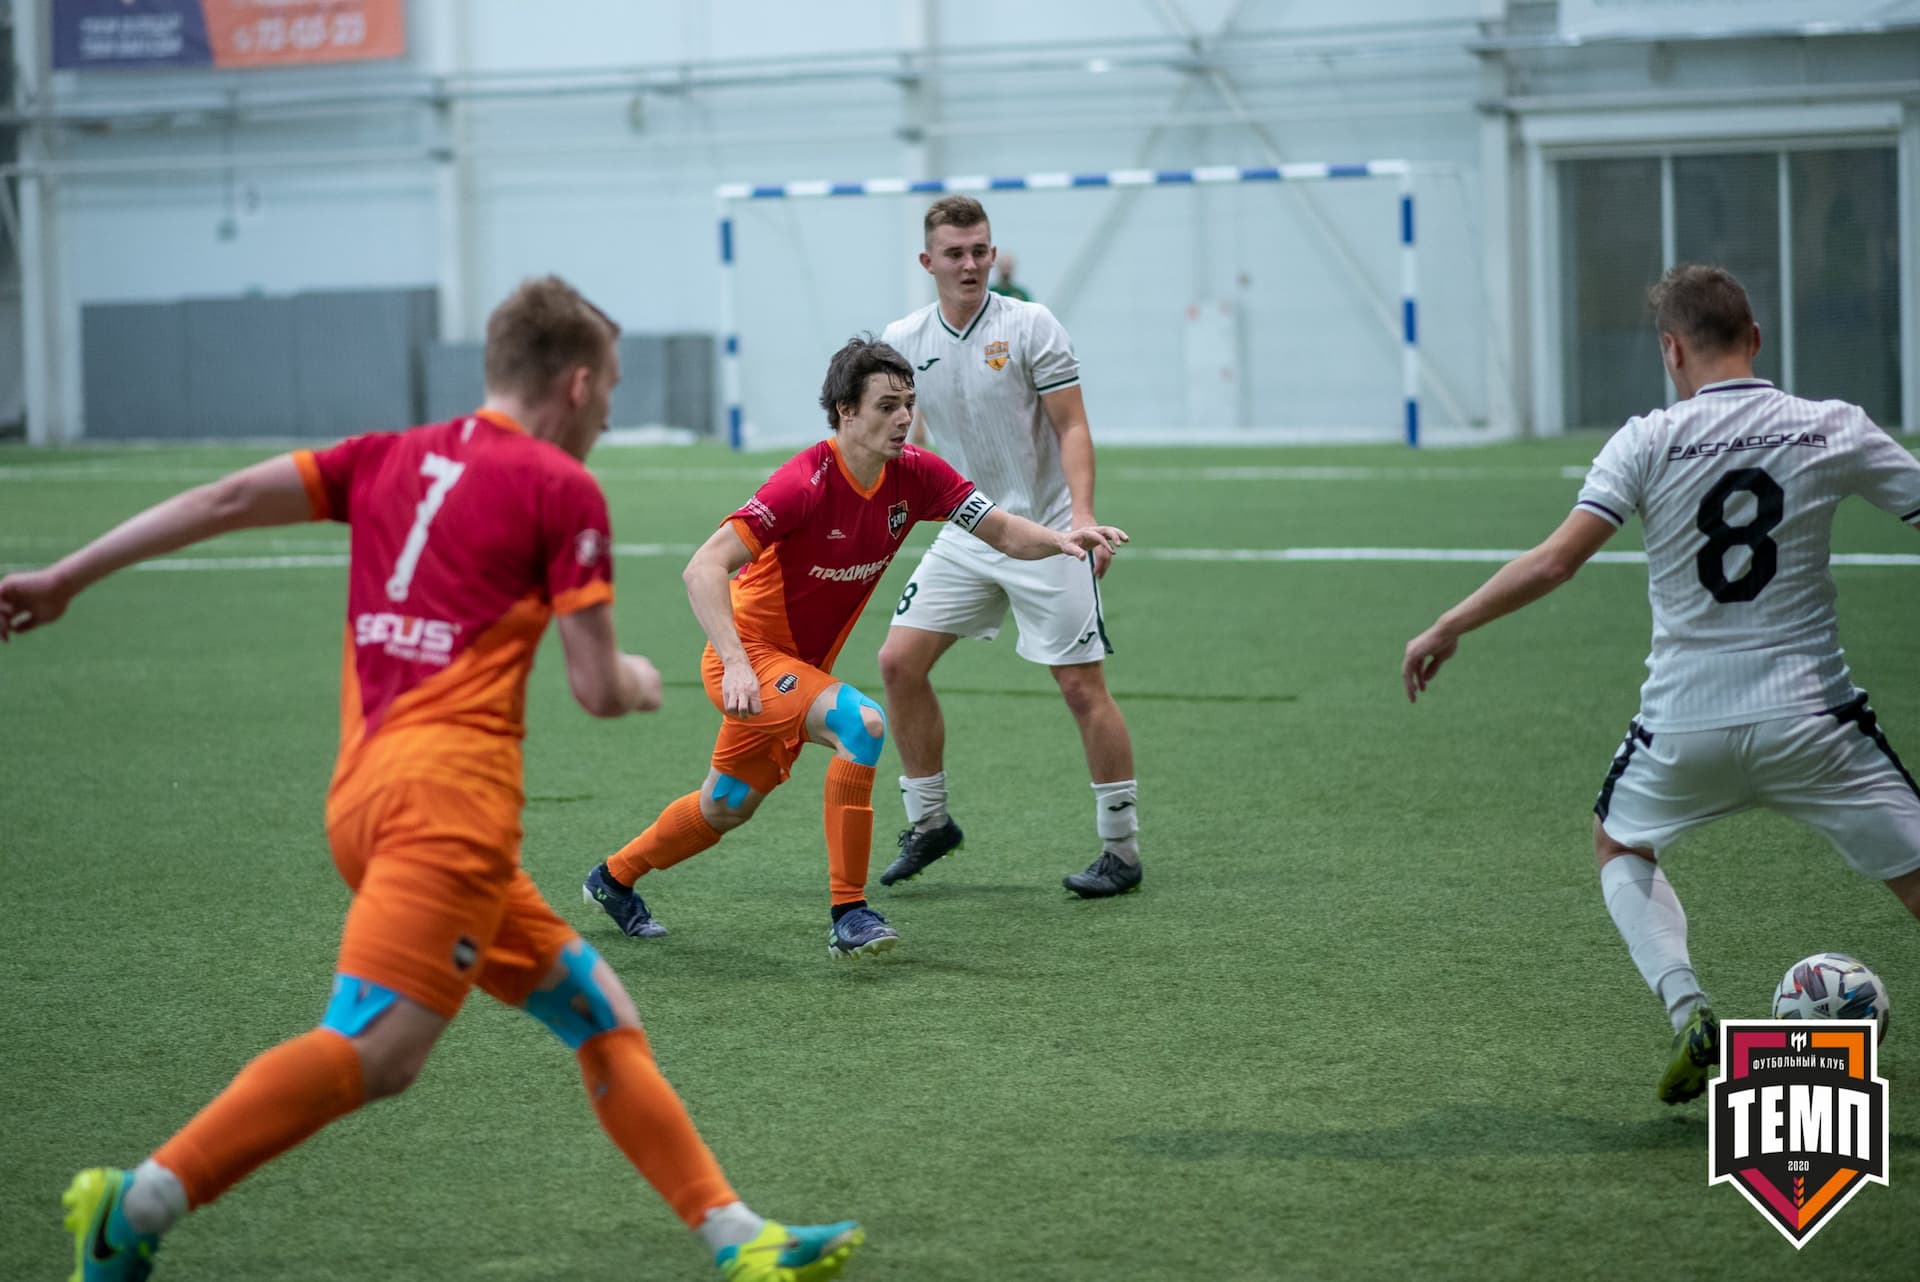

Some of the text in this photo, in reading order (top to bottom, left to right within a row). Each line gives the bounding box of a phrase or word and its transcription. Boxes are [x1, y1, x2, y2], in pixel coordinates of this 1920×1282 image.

[386, 452, 466, 602] 7
[1697, 467, 1784, 603] 8
[896, 582, 918, 615] 8
